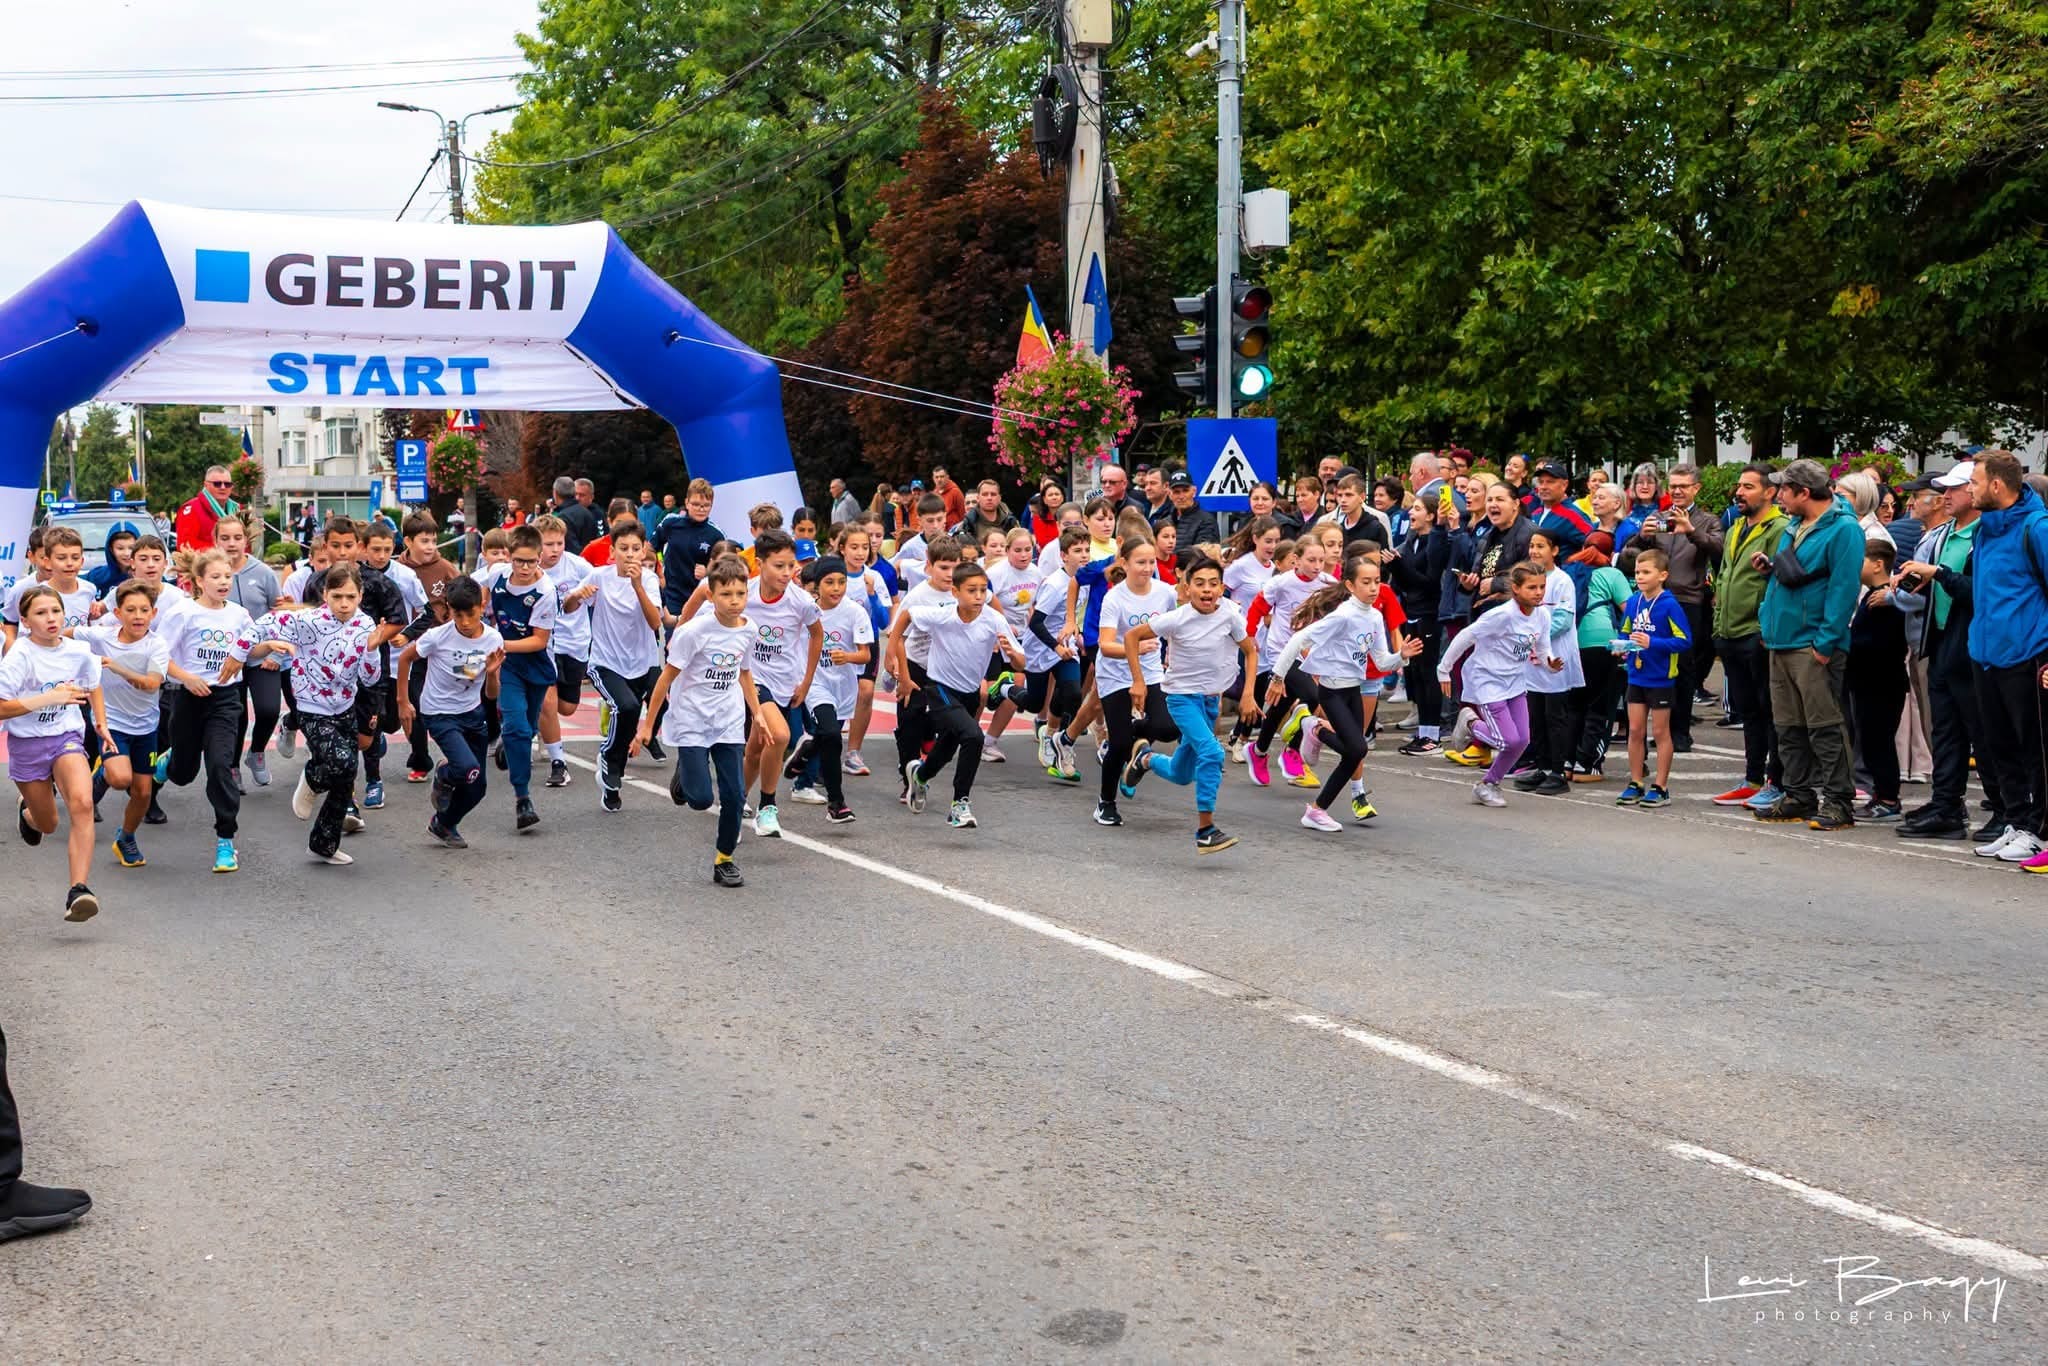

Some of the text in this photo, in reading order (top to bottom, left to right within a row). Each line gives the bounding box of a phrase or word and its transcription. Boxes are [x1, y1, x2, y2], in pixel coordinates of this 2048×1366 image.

[264, 253, 577, 311] GEBERIT
[266, 352, 490, 396] START
[404, 444, 419, 466] P
[114, 490, 122, 502] P
[712, 681, 731, 691] DAY
[38, 712, 58, 723] DAY
